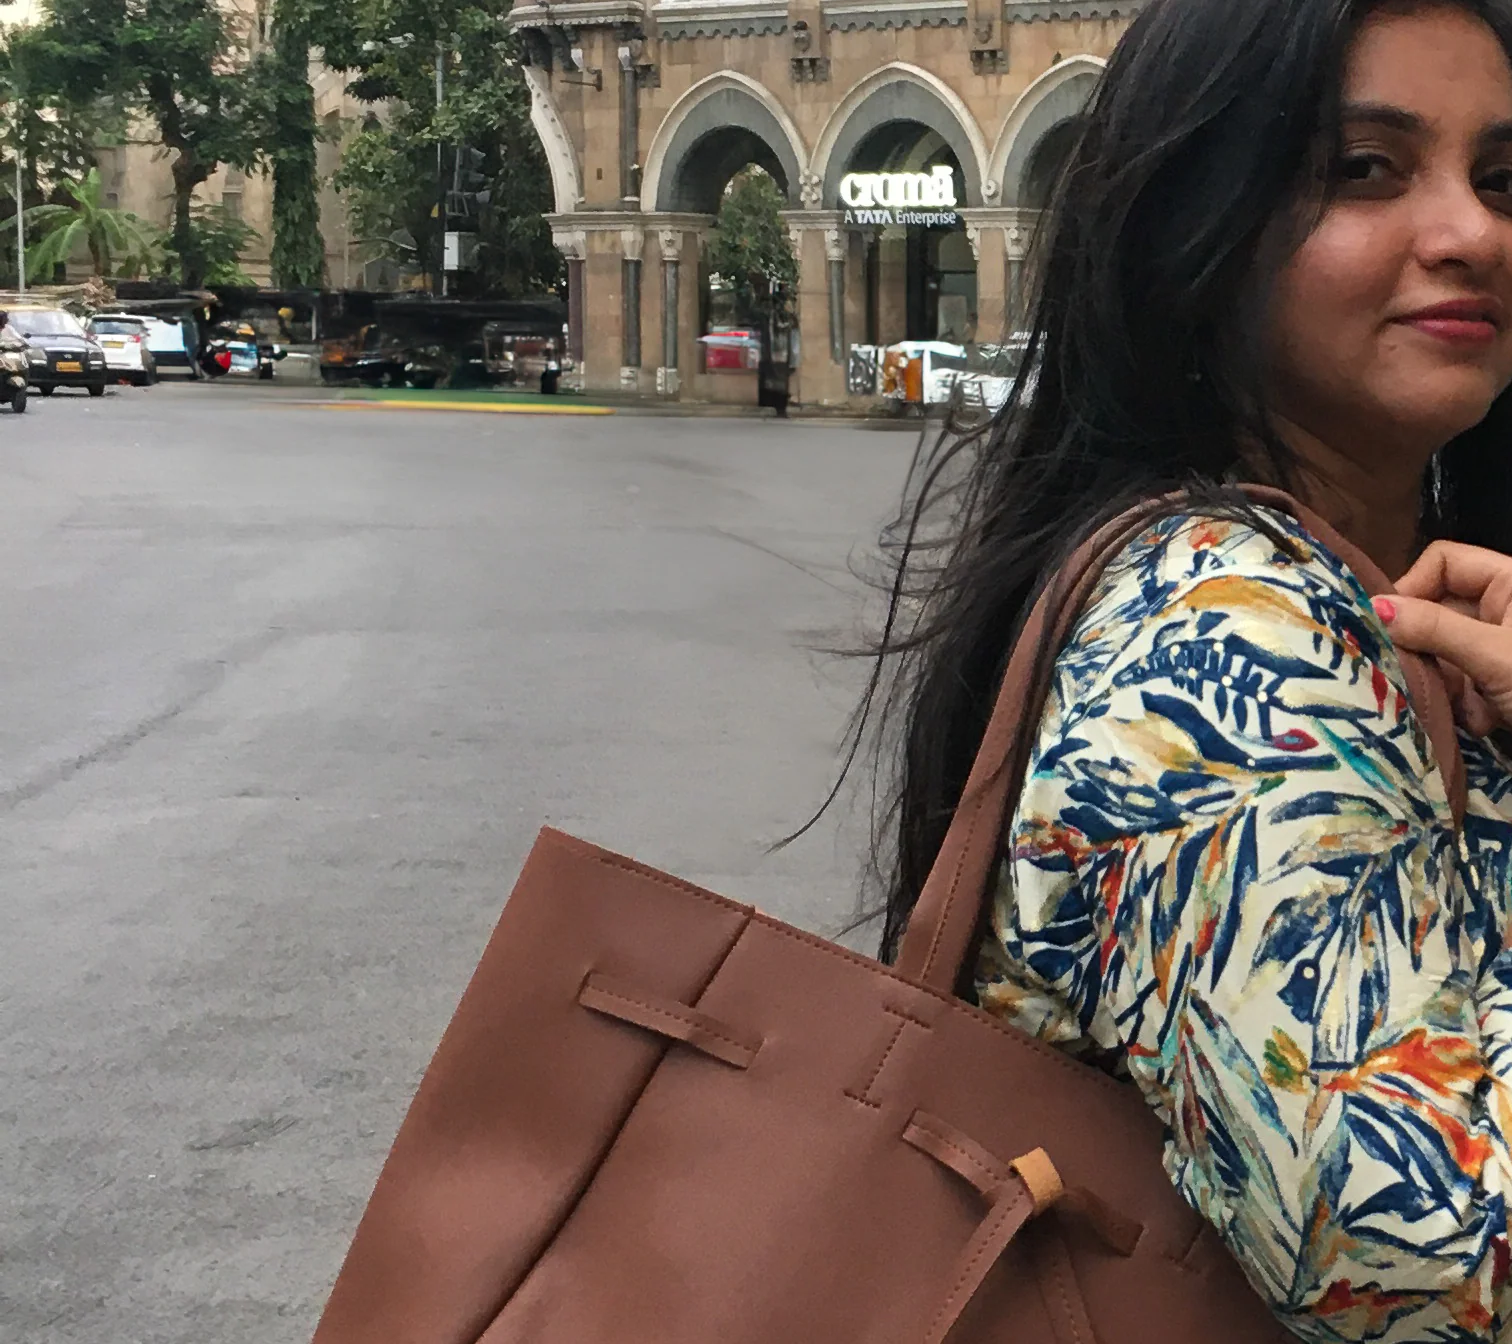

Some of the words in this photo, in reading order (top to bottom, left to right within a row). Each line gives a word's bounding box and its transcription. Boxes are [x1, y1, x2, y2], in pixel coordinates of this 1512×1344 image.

[844, 209, 853, 224] A
[854, 209, 893, 224] TATA
[896, 208, 956, 228] Enterprise
